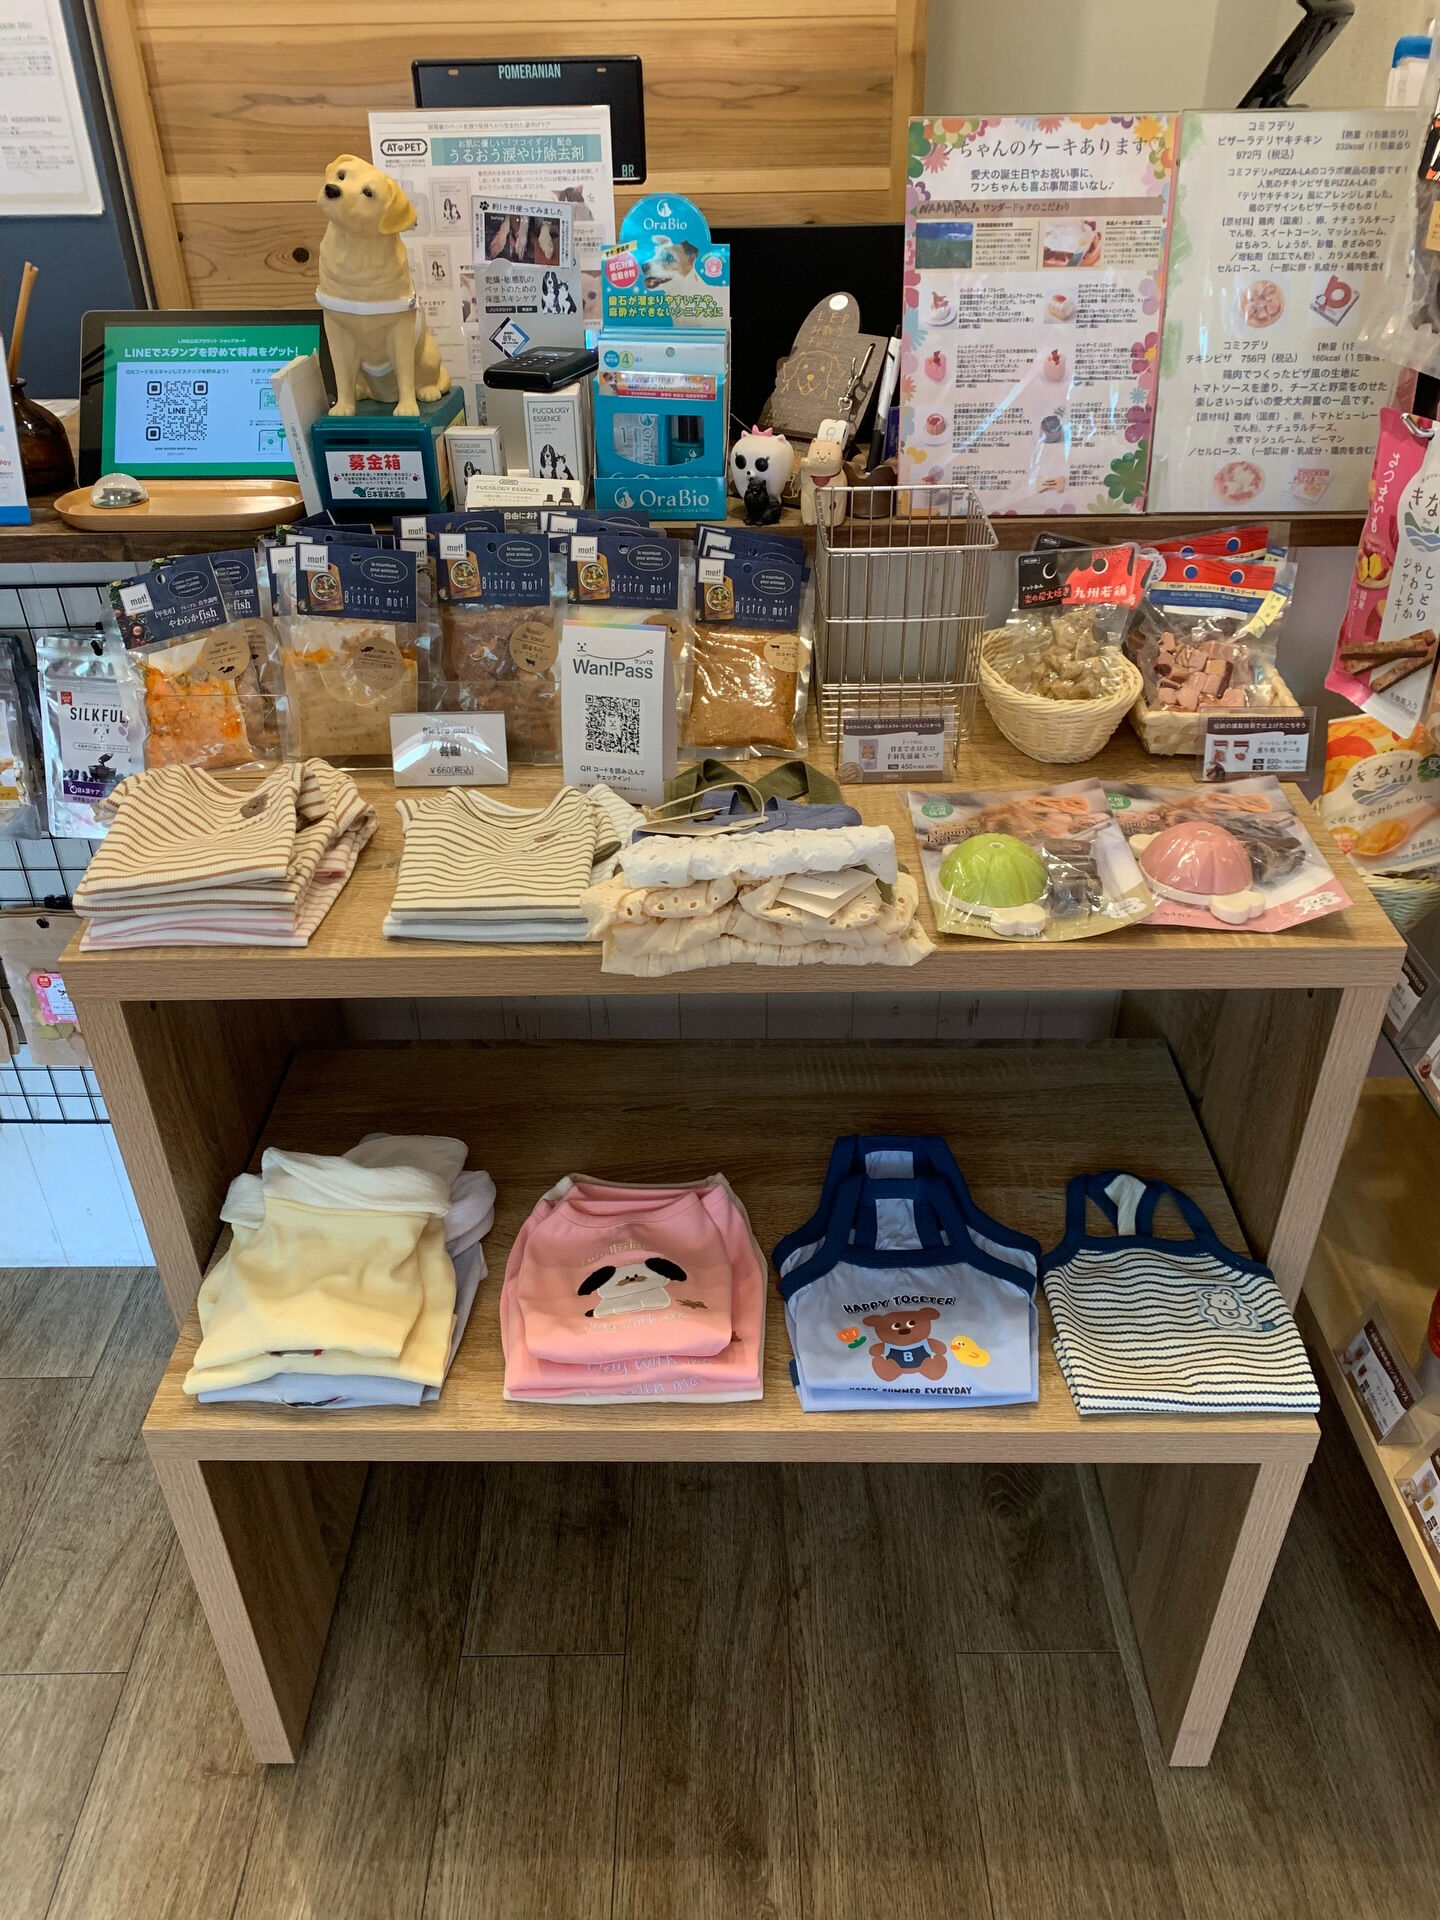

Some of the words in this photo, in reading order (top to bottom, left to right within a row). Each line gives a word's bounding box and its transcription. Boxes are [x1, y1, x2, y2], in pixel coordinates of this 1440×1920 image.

[498, 63, 561, 80] POMERANIAN
[1249, 121, 1295, 132] コミフデリ
[450, 146, 584, 163] うるおう涙やけ除去剤
[621, 164, 635, 178] BR
[971, 168, 1095, 180] 愛犬の誕生日やお祝い事に、
[492, 203, 563, 216] 約1ヶ月使ってみました
[643, 218, 688, 231] OraBio
[485, 285, 537, 294] ペットのための
[608, 307, 723, 318] 麻酔ができないシニア犬に
[124, 346, 299, 358] LINEでスタンプを貯めて特典をゲット!
[1223, 341, 1269, 351] コミフデリ
[621, 352, 630, 366] 4
[1185, 354, 1232, 364] チキンピザ
[1222, 368, 1360, 380] 鶏肉でつくったピザ風の生地に
[168, 407, 187, 415] LINE
[348, 453, 401, 471] 募金箱
[639, 489, 710, 507] OraBio
[1371, 452, 1400, 533] さつまいも
[446, 543, 464, 552] mot!
[578, 546, 595, 555] mot!
[307, 556, 325, 564] mot!
[705, 568, 722, 577] mot!
[482, 577, 516, 591] Bistro
[522, 578, 544, 591] mot!
[611, 580, 645, 594] Bistro
[650, 582, 672, 595] mot!
[1402, 561, 1422, 620] やわらか
[1074, 584, 1128, 599] 九州若鶏
[1416, 565, 1436, 622] しっとり
[130, 594, 148, 606] mot!
[344, 590, 380, 606] Bistro
[386, 595, 409, 609] mot!
[735, 601, 767, 614] Bistro
[772, 605, 793, 617] mot!
[169, 607, 218, 628] やわらかfish
[573, 658, 653, 680] Wan!Pass
[596, 774, 631, 782] チェックイン!
[1352, 758, 1414, 788] きなり
[843, 1298, 890, 1314] HAPPY
[634, 1354, 678, 1370] with
[902, 1351, 914, 1362] B
[924, 1386, 973, 1396] EVERYDAY
